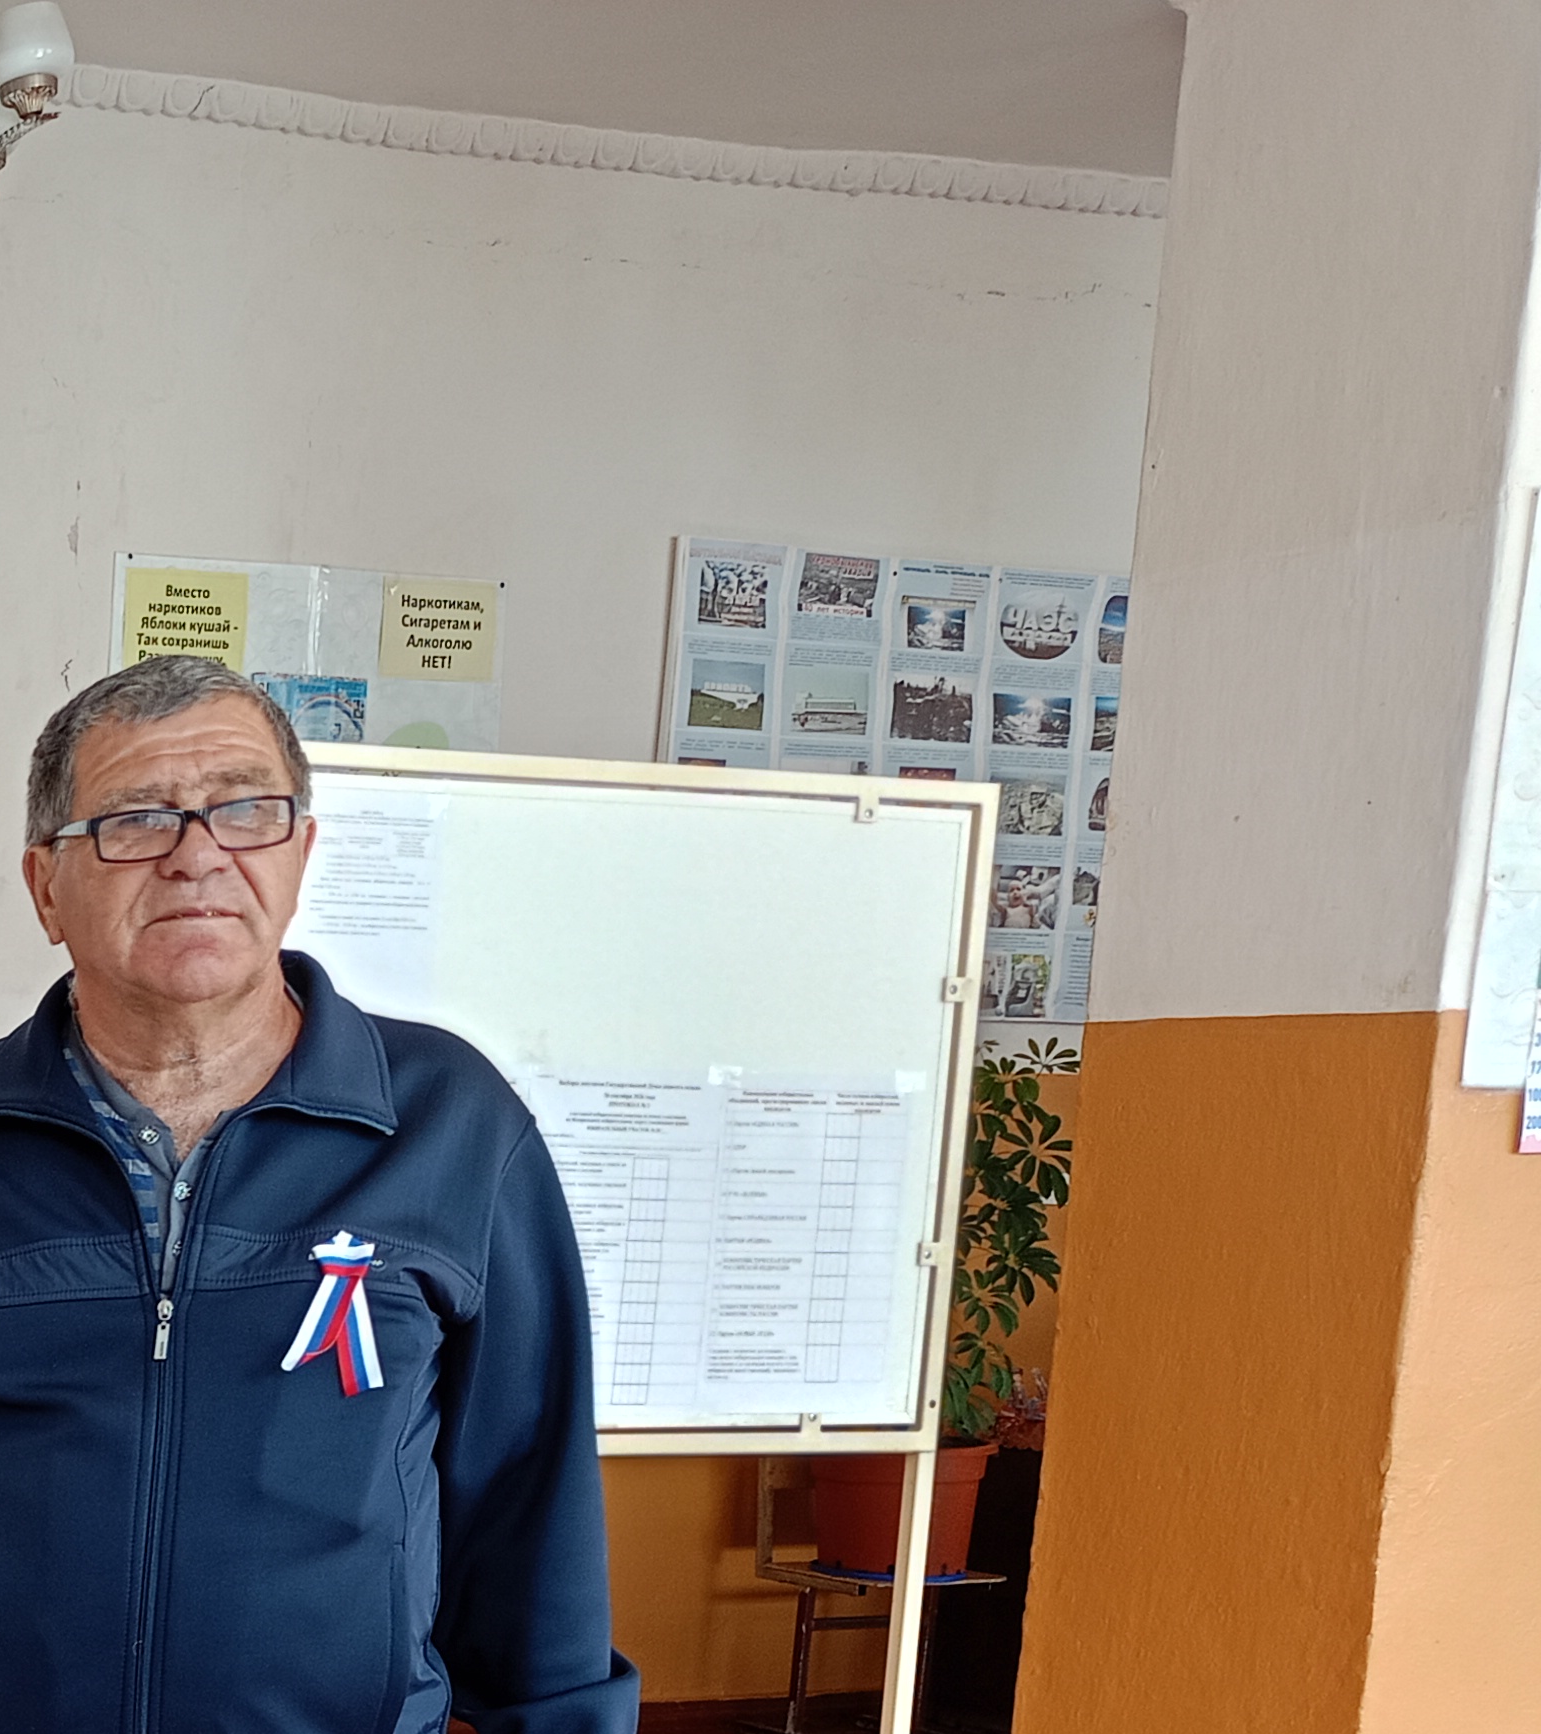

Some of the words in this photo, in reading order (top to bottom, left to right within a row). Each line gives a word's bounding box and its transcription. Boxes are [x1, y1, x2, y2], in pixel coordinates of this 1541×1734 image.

[165, 584, 211, 599] Вместо
[148, 602, 222, 616] наркотиков
[401, 594, 484, 614] Наркотикам,
[141, 616, 187, 631] Яблоки
[189, 620, 231, 635] кушай
[401, 614, 471, 632] Сигаретам
[473, 621, 482, 631] и
[136, 632, 159, 646] Так
[161, 636, 230, 650] сохранишь
[406, 634, 473, 650] Алкоголю
[421, 655, 452, 669] НЕТ!
